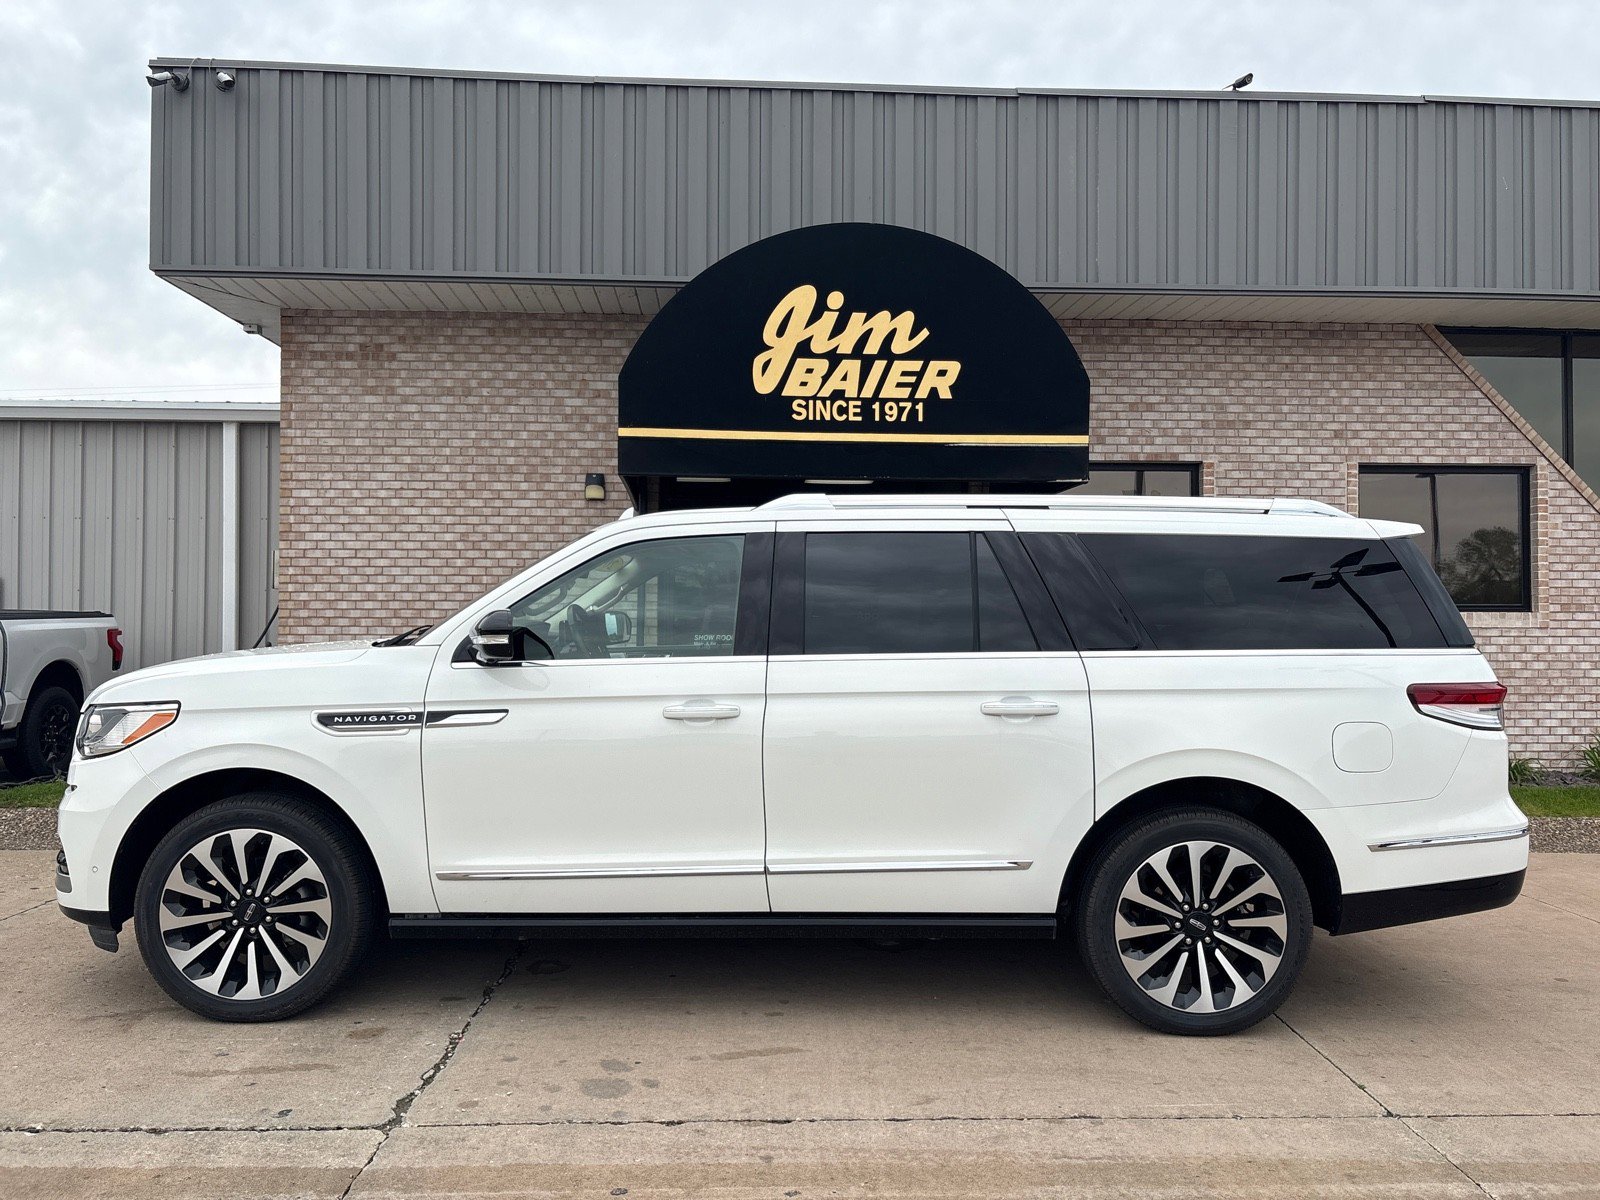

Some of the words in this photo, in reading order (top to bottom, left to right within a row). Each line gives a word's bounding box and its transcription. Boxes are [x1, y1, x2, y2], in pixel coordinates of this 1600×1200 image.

[752, 284, 930, 395] Jim
[781, 358, 962, 399] BAIER
[791, 399, 863, 422] SINCE
[873, 401, 924, 422] 1971
[333, 714, 417, 723] NAVIGATOR
